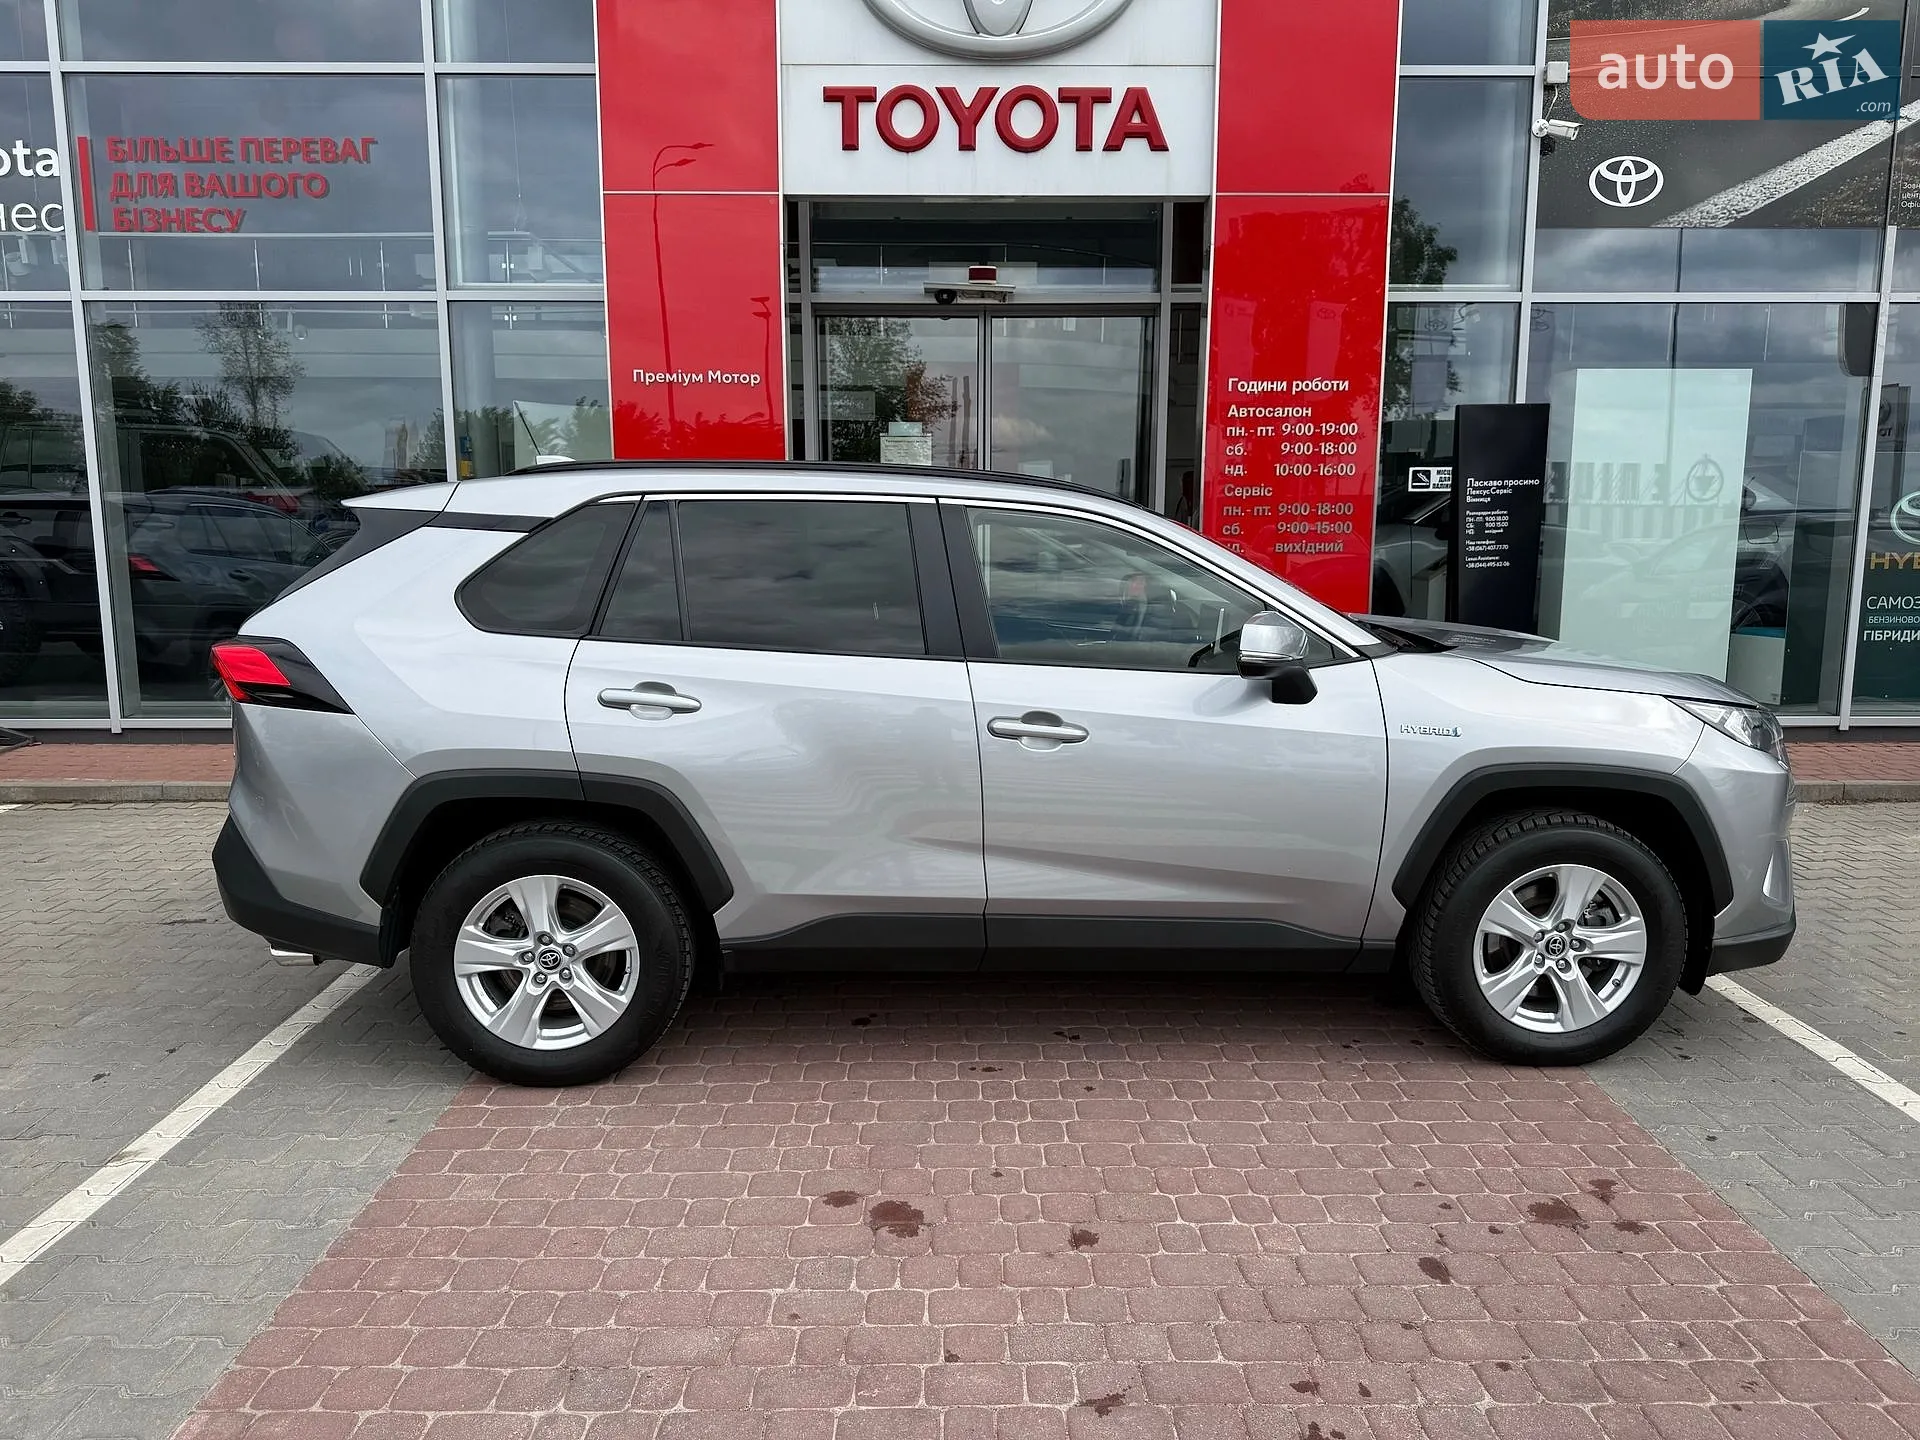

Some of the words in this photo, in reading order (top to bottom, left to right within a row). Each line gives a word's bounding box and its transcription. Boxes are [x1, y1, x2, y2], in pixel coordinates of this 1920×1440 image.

[823, 84, 1170, 153] TOYOTA
[106, 136, 234, 163] БІЛЬШЕ
[239, 137, 377, 164] ПЕРЕВАГ
[110, 172, 176, 202] ДЛЯ
[184, 172, 329, 199] ВАШОГО
[113, 207, 245, 233] БІЗНЕСУ
[632, 369, 704, 386] Преміум
[707, 370, 761, 387] Мотор
[1228, 378, 1287, 394] Години
[1292, 377, 1349, 395] роботи
[1227, 405, 1312, 418] Автосалон
[1281, 422, 1358, 437] 9:00-19:00
[1226, 444, 1248, 456] сб.
[1280, 442, 1357, 456] 9:00-18:00
[1224, 464, 1248, 476] нд.
[1274, 463, 1356, 477] 10:00-16:00
[1466, 478, 1503, 487] Ласкаво
[1503, 479, 1540, 487] просимо
[1224, 483, 1273, 499] Сервіс
[1278, 502, 1354, 516] 9:00-18:00
[1222, 522, 1244, 535] сб.
[1277, 521, 1352, 535] 9:00-15:00
[1275, 540, 1344, 554] вихідний
[1400, 724, 1454, 737] HYBRID
